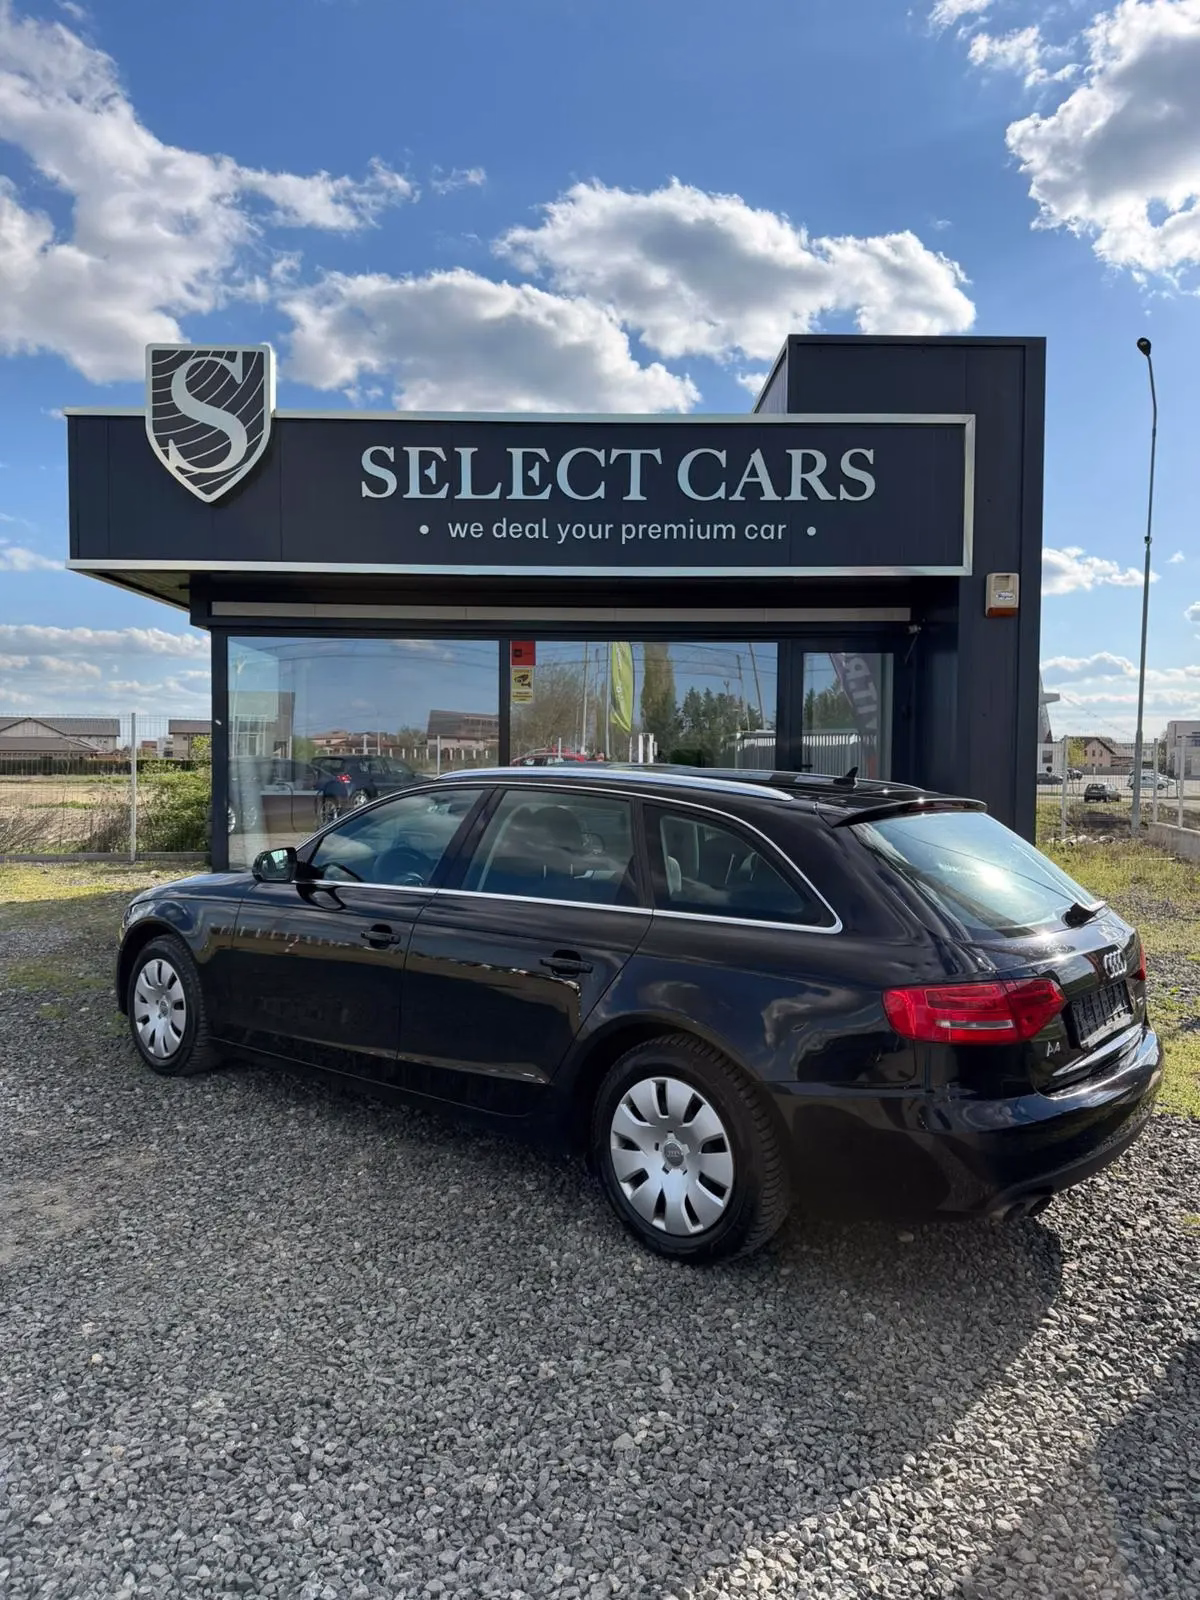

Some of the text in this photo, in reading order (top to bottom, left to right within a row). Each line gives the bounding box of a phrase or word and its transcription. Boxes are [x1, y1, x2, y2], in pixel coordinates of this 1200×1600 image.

[169, 351, 248, 473] S
[361, 445, 877, 501] SELECT CARS
[447, 517, 787, 545] we deal your premium car
[1046, 1041, 1061, 1057] A4
